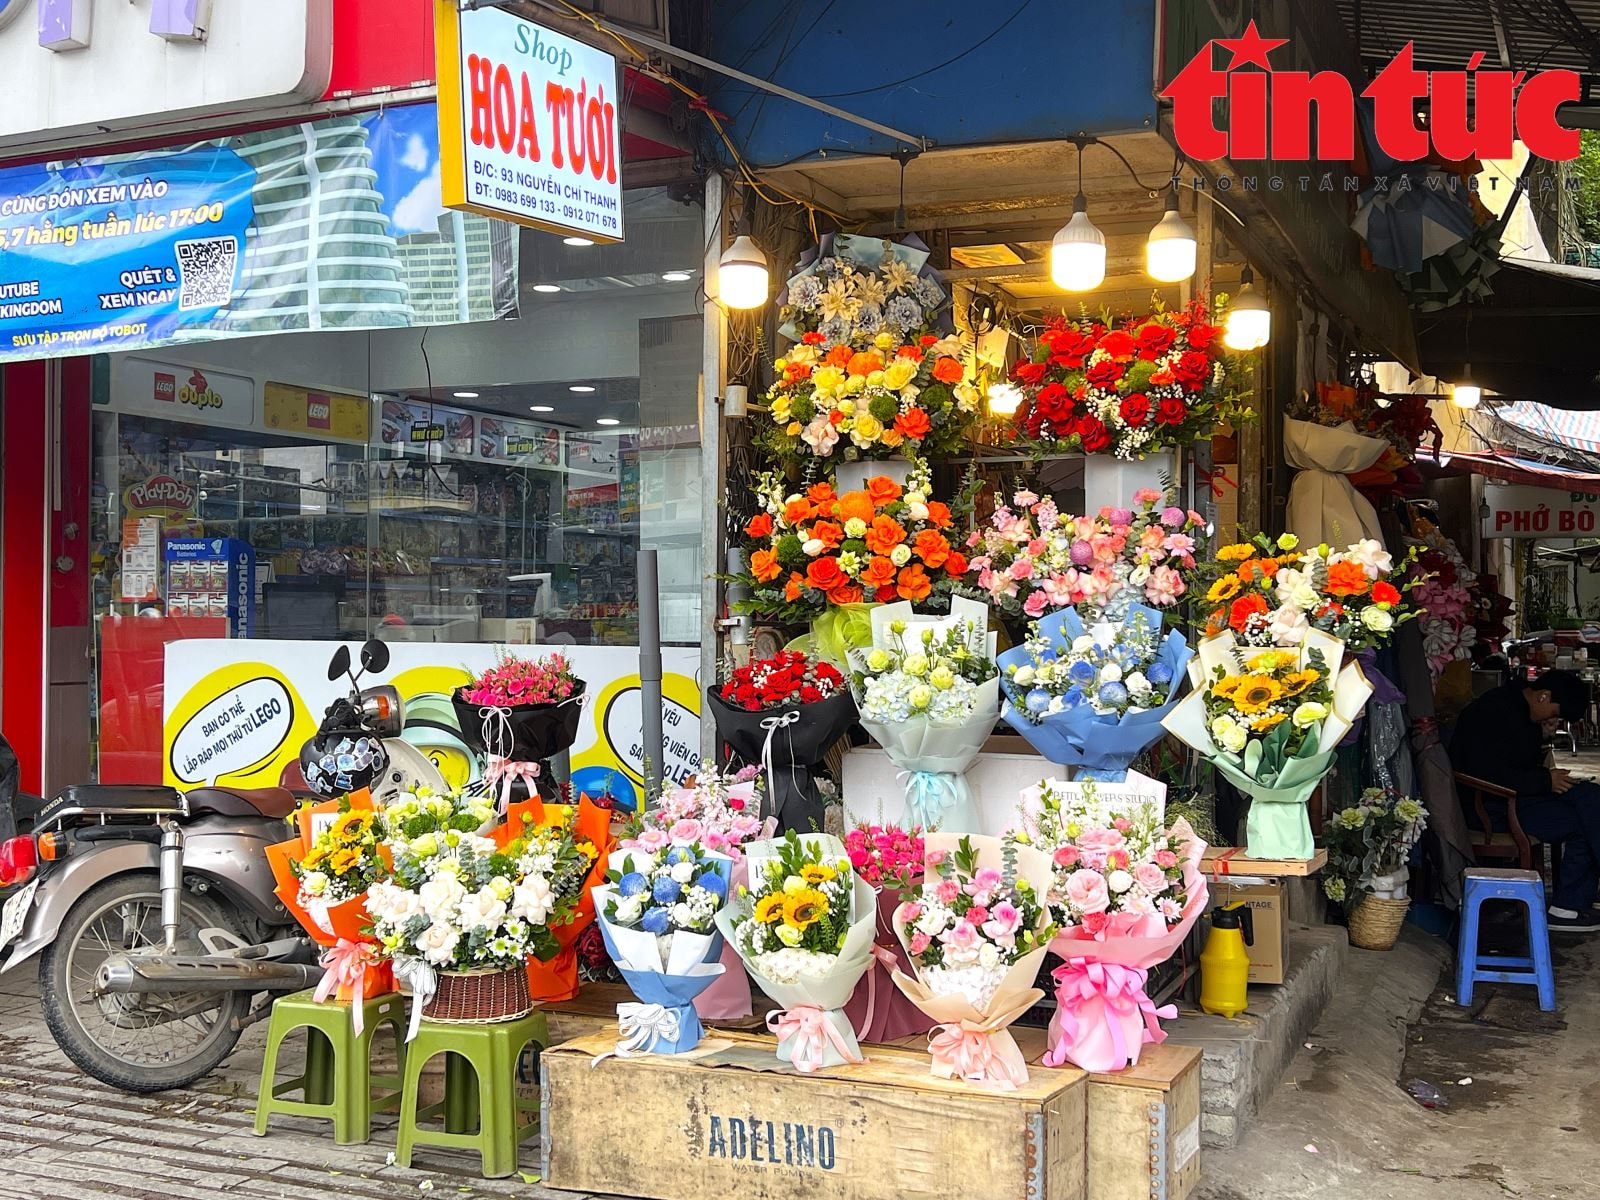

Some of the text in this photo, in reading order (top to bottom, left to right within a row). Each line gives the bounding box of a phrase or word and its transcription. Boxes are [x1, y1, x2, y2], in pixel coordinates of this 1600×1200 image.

[514, 23, 573, 76] Shop
[468, 53, 617, 185] HOA TƯƠI
[1, 178, 168, 216] CÙNG ĐÓN XEM VÀO
[474, 160, 617, 211] Đ/C: 93 NGUYỄN CHÍ THANH
[475, 182, 492, 197] ĐT:
[495, 187, 518, 204] 0983
[520, 194, 537, 209] 699
[540, 199, 555, 213] 133
[563, 205, 583, 220] 0912
[585, 210, 600, 224] 071
[602, 215, 617, 229] 678
[25, 216, 78, 247] hằng
[82, 212, 130, 240] tuần
[134, 211, 166, 234] lúc
[169, 201, 224, 228] 17:00
[120, 266, 177, 289] QUÉT &
[99, 287, 177, 310] XEM NGAY
[109, 323, 147, 338] TOBOT
[156, 381, 223, 409] LEGO duplo
[308, 404, 328, 418] LEGO
[131, 482, 195, 507] Play-Doh
[1495, 503, 1595, 532] PHỞ BÒ
[167, 541, 206, 550] Panasonic
[235, 552, 249, 639] anasonic
[202, 718, 220, 737] BẠN
[218, 709, 230, 727] CÓ
[250, 697, 282, 729] LEGO
[40, 796, 64, 816] HONDA
[709, 1115, 835, 1170] ADELINO
[731, 1162, 768, 1175] WATER
